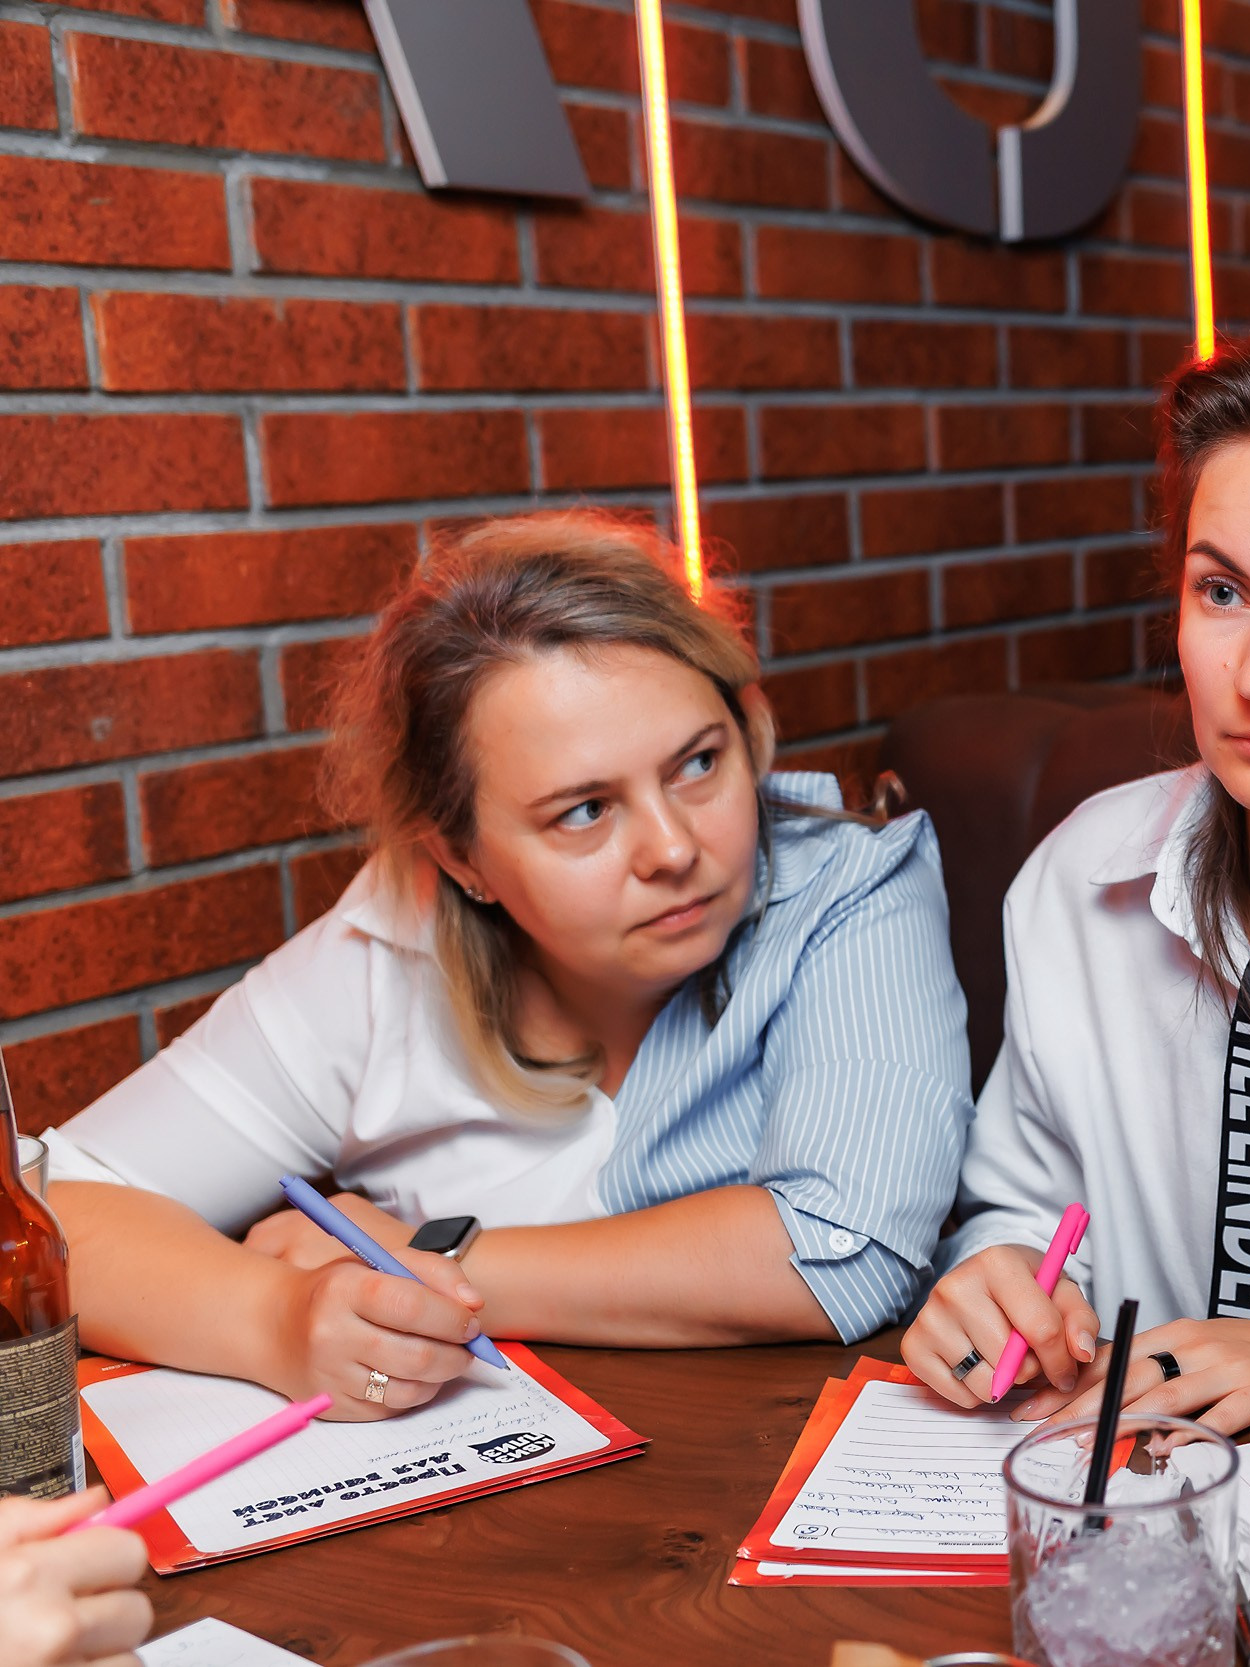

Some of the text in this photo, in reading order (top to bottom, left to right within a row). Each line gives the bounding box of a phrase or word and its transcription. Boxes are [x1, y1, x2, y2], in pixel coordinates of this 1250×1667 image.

[232, 1452, 452, 1518] для записей
[242, 1463, 467, 1528] Просто лист
